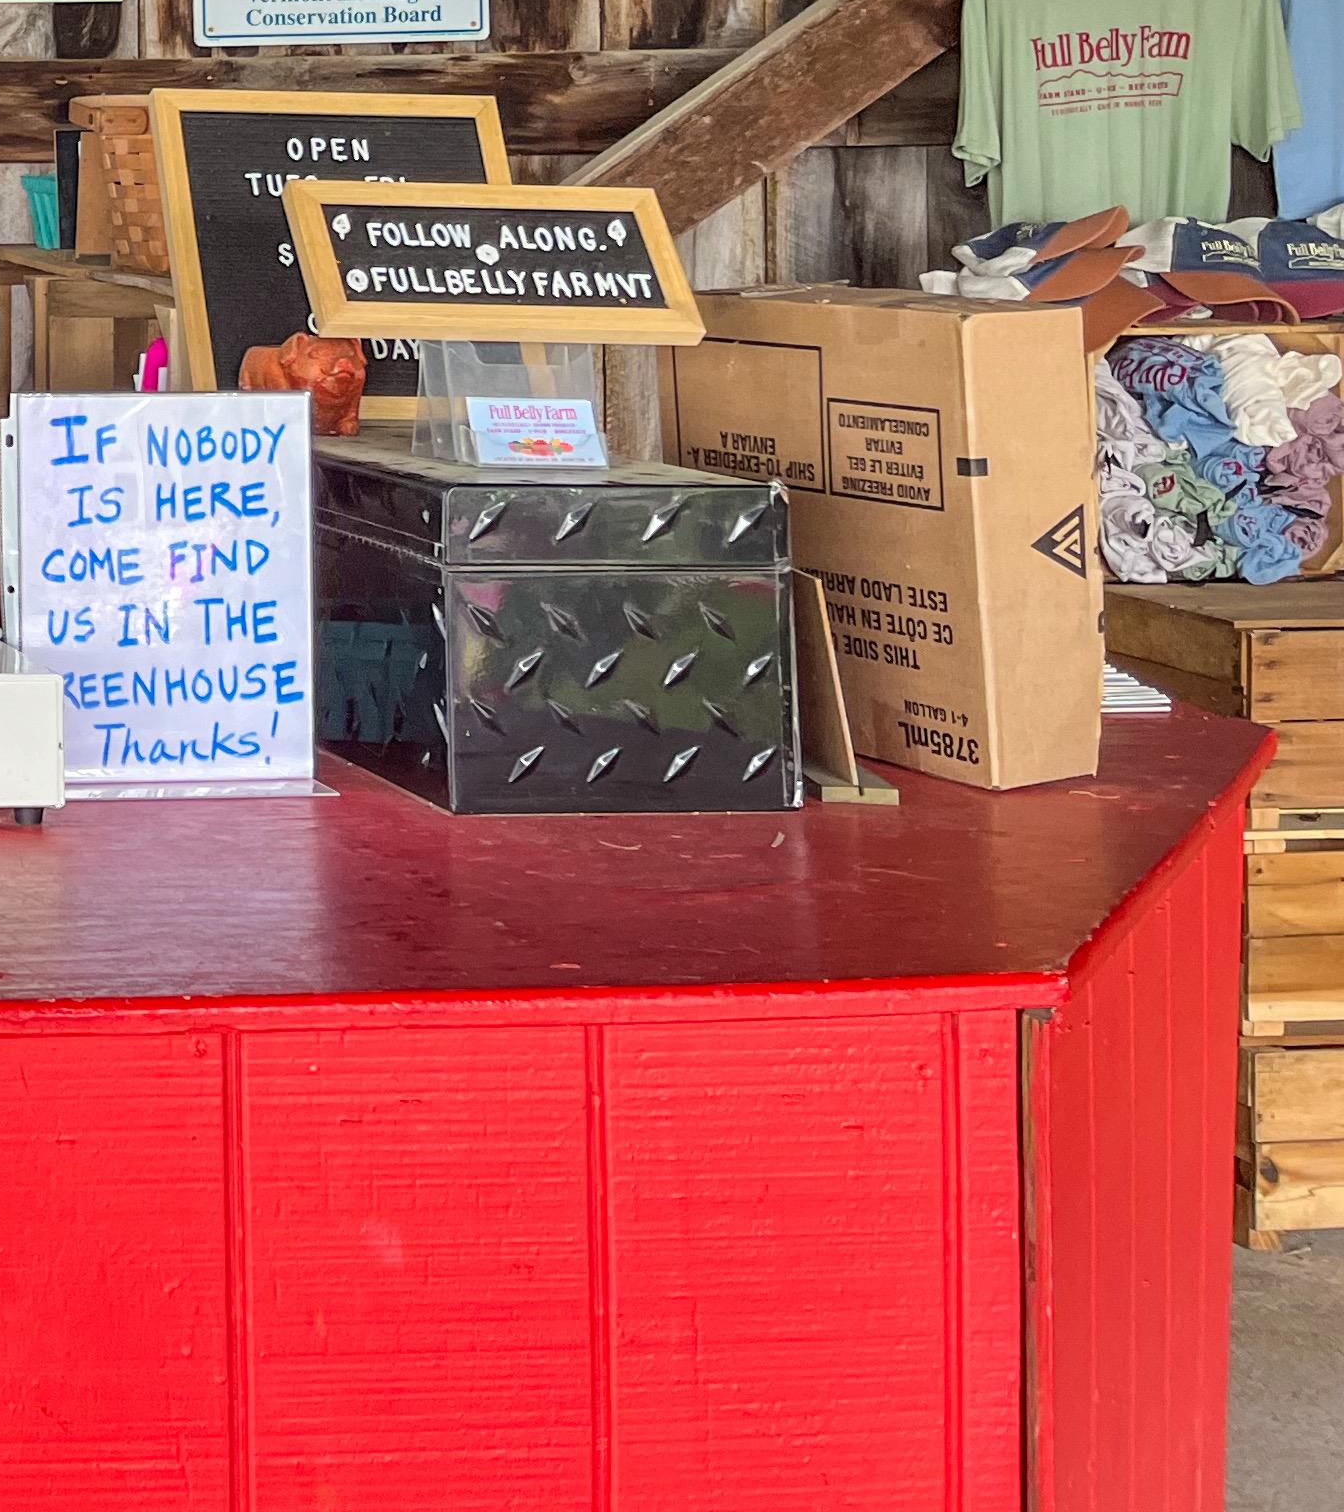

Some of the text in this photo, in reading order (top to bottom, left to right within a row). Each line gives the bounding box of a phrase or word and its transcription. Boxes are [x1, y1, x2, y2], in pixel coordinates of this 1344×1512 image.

[245, 4, 442, 27] Conservation Board
[1031, 34, 1072, 71] Full
[1076, 28, 1137, 67] Belly
[286, 138, 370, 162] OPEN
[244, 173, 318, 197] TU
[366, 222, 608, 252] FOLLOW ALONG.
[489, 405, 577, 422] Full Belly Farm
[839, 413, 929, 437] CONGELAMIENTO
[50, 415, 285, 467] IF NOBODY
[720, 431, 776, 455] ENVIAR A
[865, 438, 903, 455] EVITAR
[786, 461, 815, 482] SHIP
[846, 455, 867, 471] GEL
[870, 459, 883, 474] LE
[842, 476, 930, 501] AVOID FREEZING
[67, 482, 280, 528] IS HERE,
[41, 539, 269, 585] COME FIND
[861, 578, 902, 599] LADO
[908, 586, 948, 613] ESTE
[47, 598, 278, 646] US IN THE
[826, 602, 856, 625] HAU
[862, 609, 881, 630] EN
[932, 622, 953, 645] CE
[844, 635, 878, 661] SIDE
[884, 644, 920, 670] THIS
[63, 660, 304, 709] REENHOUSE
[904, 700, 969, 727] 4-1 GALLON
[94, 712, 278, 767] Thanks!
[898, 721, 979, 764] 3785mL
